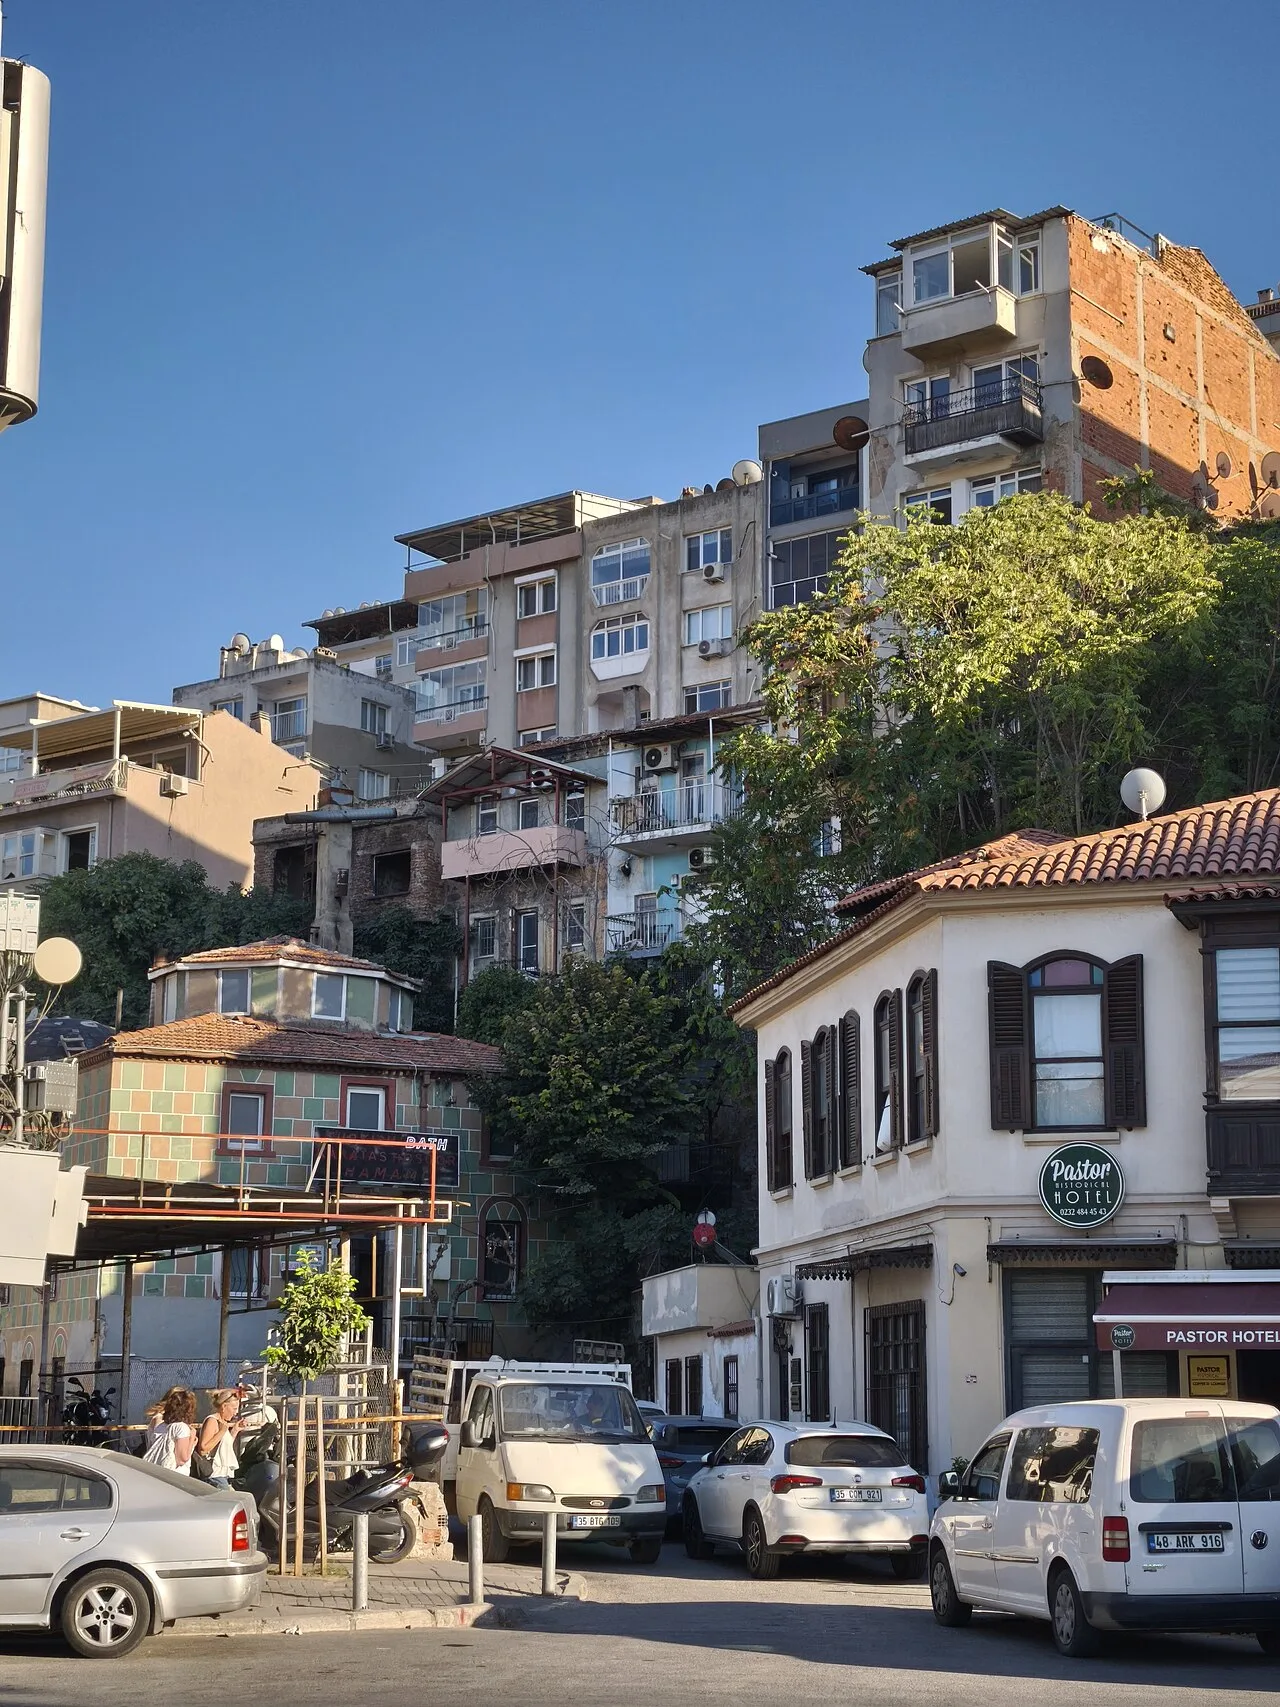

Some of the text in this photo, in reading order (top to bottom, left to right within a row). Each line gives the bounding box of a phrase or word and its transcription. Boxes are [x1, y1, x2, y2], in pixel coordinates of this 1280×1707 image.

[405, 1136, 448, 1151] BATH
[1050, 1159, 1111, 1182] Pastor
[1055, 1181, 1110, 1189] HISTORICAL
[1054, 1190, 1112, 1205] HOTEL
[1060, 1207, 1107, 1216] 0232 484 45 43
[1166, 1330, 1280, 1343] PASTOR HOTEL
[835, 1489, 845, 1499] 35
[867, 1490, 880, 1500] 921
[578, 1516, 587, 1526] 35
[1156, 1535, 1169, 1548] 48
[1176, 1535, 1196, 1548] ARK
[1201, 1535, 1221, 1548] 916
